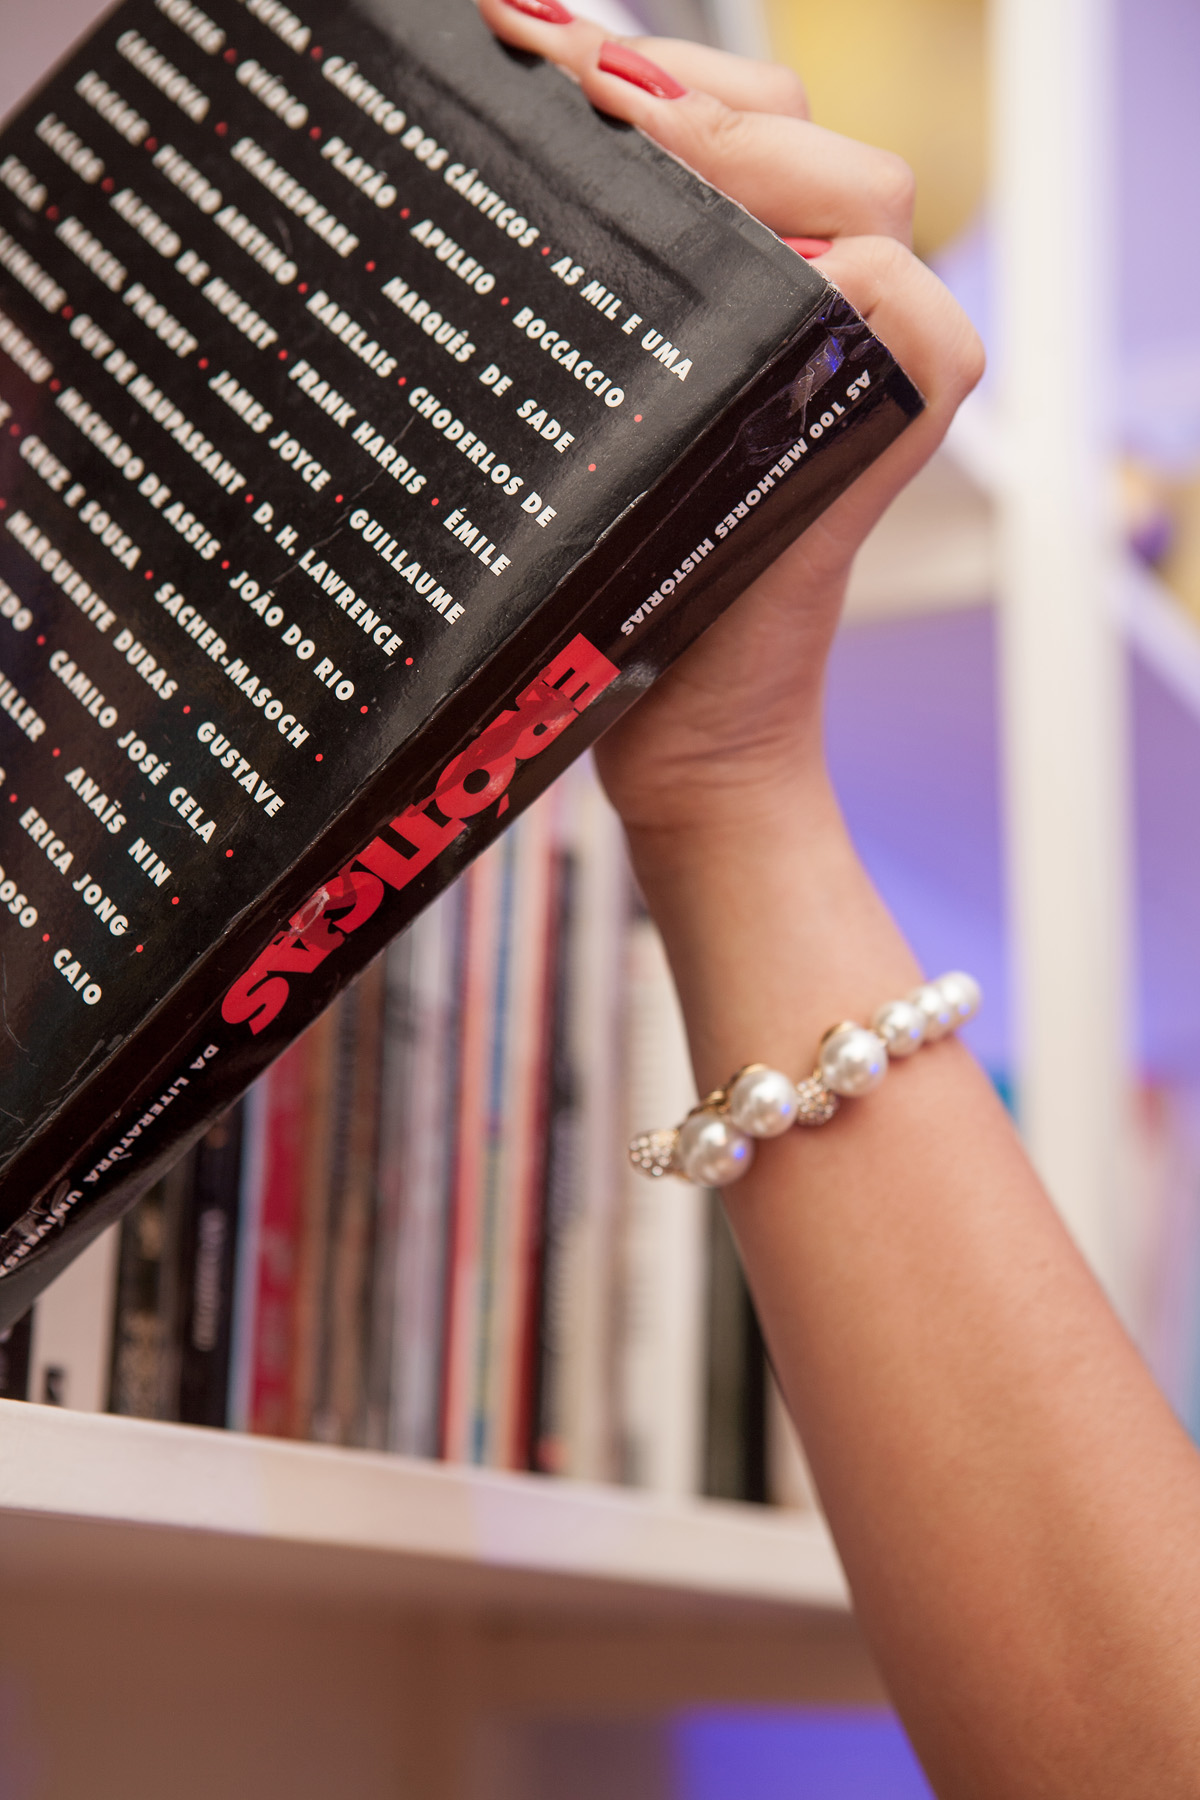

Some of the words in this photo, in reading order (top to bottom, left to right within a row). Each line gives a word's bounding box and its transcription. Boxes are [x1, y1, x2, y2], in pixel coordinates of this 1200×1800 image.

[37, 115, 104, 182] LACLOS
[111, 189, 182, 258] ALFRED
[176, 251, 208, 283] DE
[202, 277, 280, 351] MUSSET
[289, 361, 355, 426] FRANK
[352, 422, 426, 493] HARRIS
[443, 508, 511, 576] ÉMILE
[117, 30, 210, 121] CASANOVA
[231, 137, 361, 258] SHAKESPEARE
[382, 278, 475, 361] MARQUÊS
[479, 365, 512, 396] DE
[517, 400, 576, 454] SADE
[153, 145, 223, 214] PIETRO
[214, 206, 299, 286] ARETINO
[307, 291, 396, 376] RABELAIS
[409, 388, 523, 495] CHODERLOS
[521, 492, 557, 527] DE
[322, 138, 396, 206] PLATÃO
[411, 220, 495, 293] APULEIO
[513, 307, 626, 409] BOCCACCIO
[323, 57, 405, 132] CÂNTICO
[401, 126, 448, 168] DOS
[445, 164, 539, 246] CÂNTICOS
[551, 257, 584, 284] AS
[580, 281, 622, 319] MIL
[622, 314, 642, 334] E
[642, 329, 692, 381] UMA
[0, 226, 66, 313] LINAIRE
[70, 314, 114, 359] GUY
[105, 351, 135, 383] DE
[127, 375, 248, 496] MAUPASSANT
[253, 503, 273, 531] D.
[276, 525, 298, 555] H.
[299, 549, 403, 656] LAWRENCE
[56, 217, 127, 292] MARCEL
[123, 283, 199, 358] PROUST
[209, 372, 272, 432] JAMES
[269, 432, 330, 491] JOYCE
[350, 510, 465, 624] GUILLAUME
[715, 437, 809, 539] MELHORES
[809, 401, 845, 439] 100
[846, 369, 871, 401] AS
[5, 510, 118, 634] MARGUERITE
[114, 629, 177, 699] DURAS
[198, 722, 284, 817] GUSTAVE
[19, 435, 71, 492] CRUZ
[65, 485, 83, 505] E
[80, 502, 139, 569] SOUSA
[155, 584, 309, 748] SACHER-MASOCH
[56, 388, 146, 482] MACHADO
[139, 474, 169, 507] DE
[163, 503, 220, 559] ASSIS
[230, 572, 283, 626] JOÃO
[282, 624, 315, 659] DO
[314, 657, 354, 700] RIO
[620, 537, 715, 636] HISTÓRIAS
[0, 673, 44, 741] ILLER
[65, 767, 126, 833] ANAÏS
[128, 838, 171, 886] NIN
[20, 807, 73, 874] ERICA
[73, 874, 127, 935] JONG
[50, 651, 117, 727] CAMILO
[118, 731, 170, 785] JOSÉ
[170, 787, 216, 843] CELA
[221, 633, 622, 1036] ERÓTICAS
[54, 949, 101, 1004] CAIO
[189, 1044, 220, 1069] DA
[83, 1076, 190, 1183] LITERATURA
